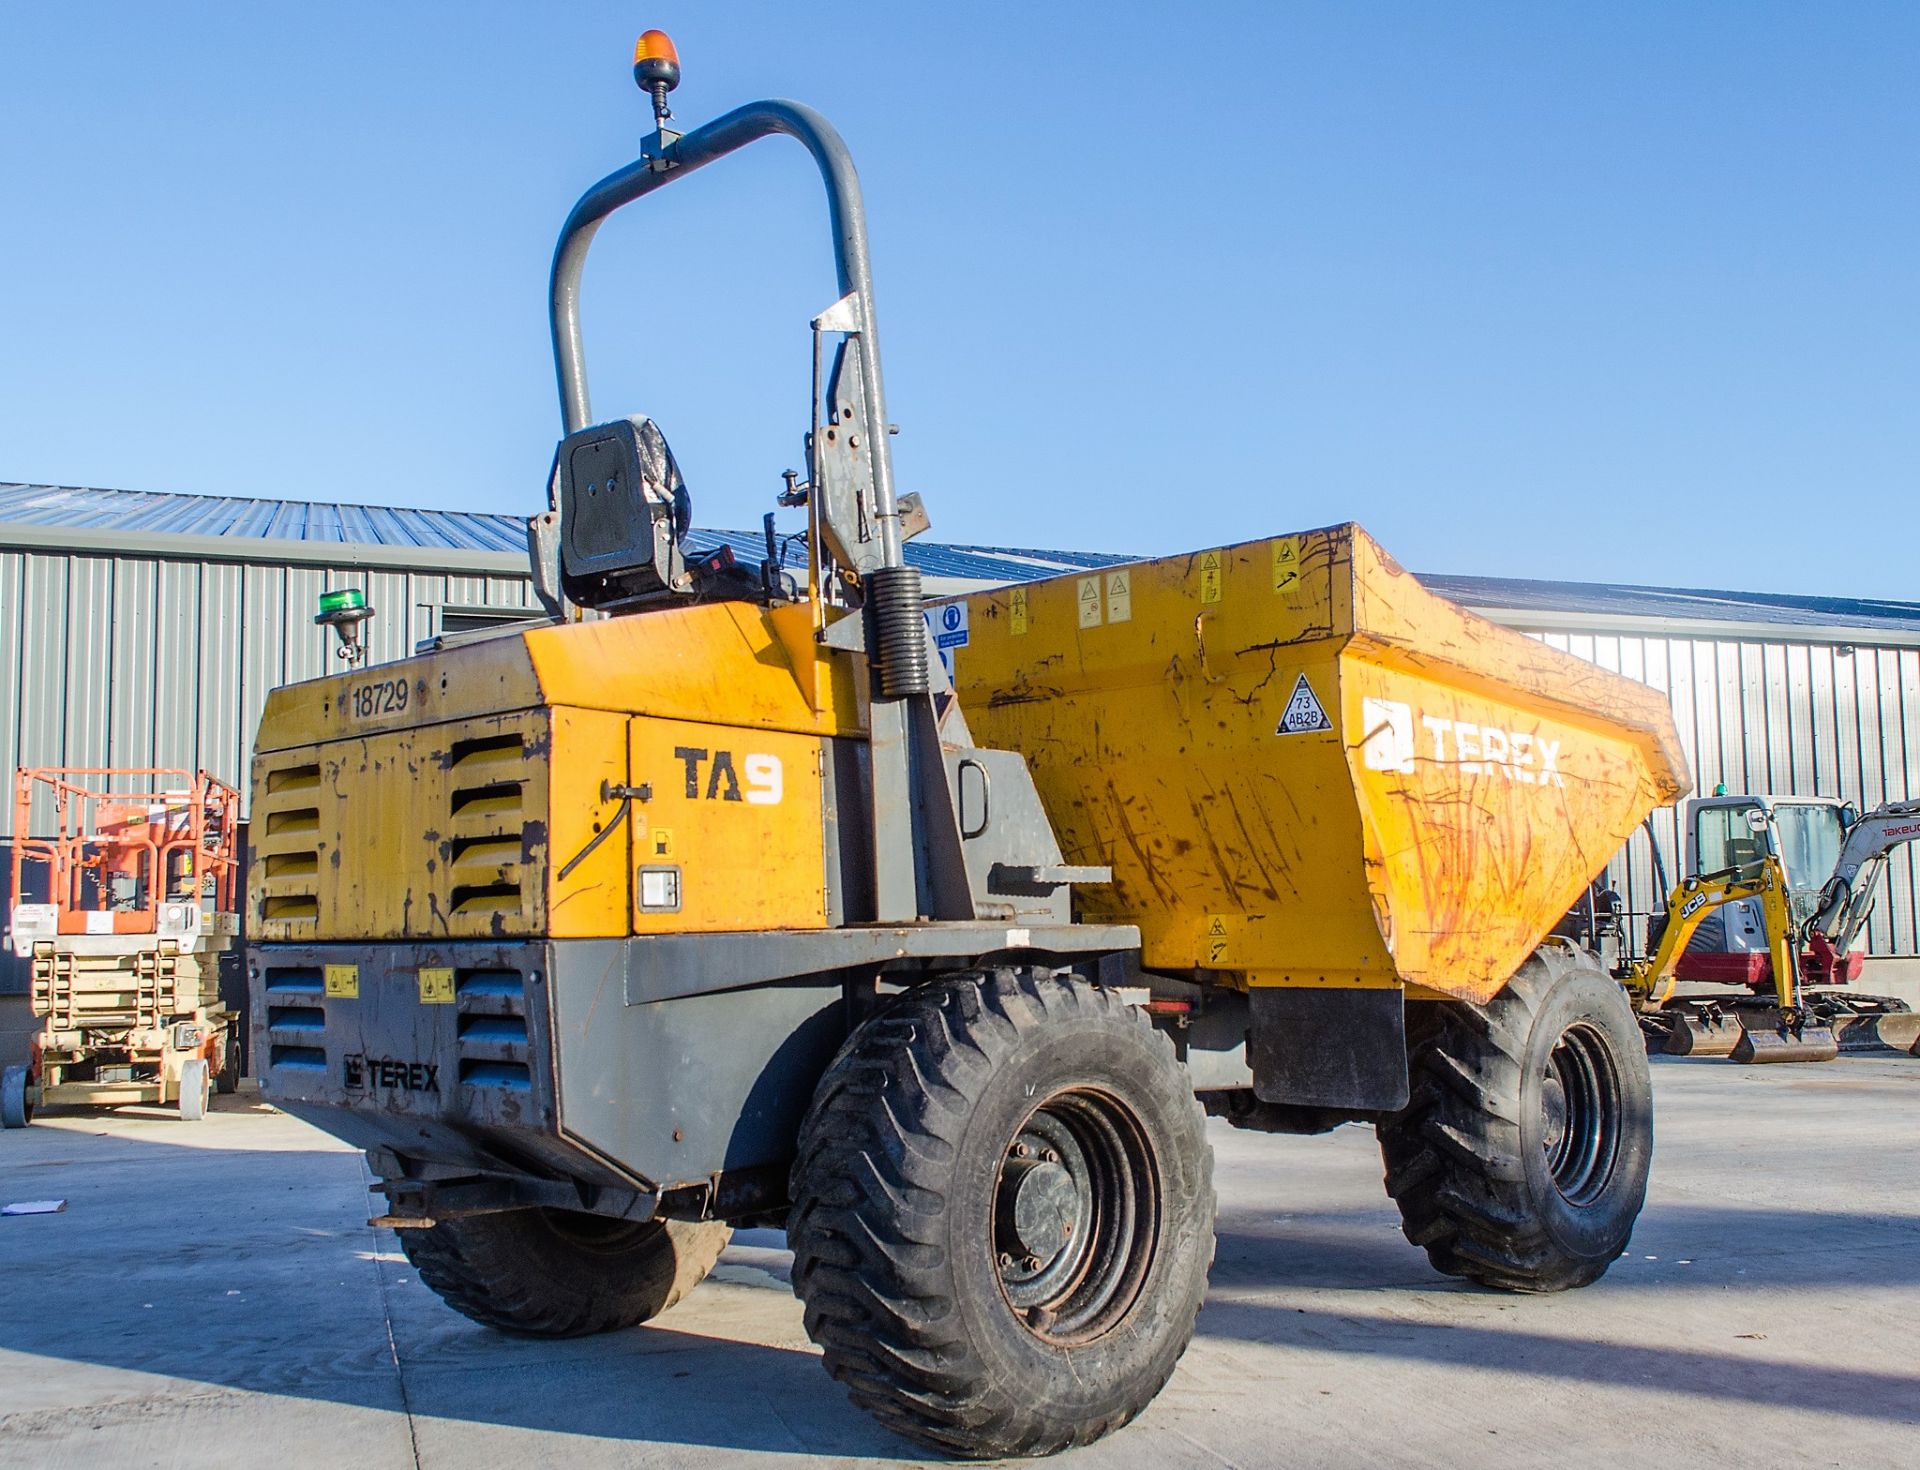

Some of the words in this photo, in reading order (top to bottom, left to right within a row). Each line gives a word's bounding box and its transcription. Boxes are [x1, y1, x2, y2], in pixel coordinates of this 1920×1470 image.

[353, 678, 408, 718] 18729
[1296, 697, 1310, 709] 73
[1289, 711, 1318, 726] AB2B
[1423, 715, 1565, 789] TEREX
[674, 746, 783, 805] TA9
[1680, 892, 1706, 919] JCB
[367, 1060, 439, 1092] TEREX
